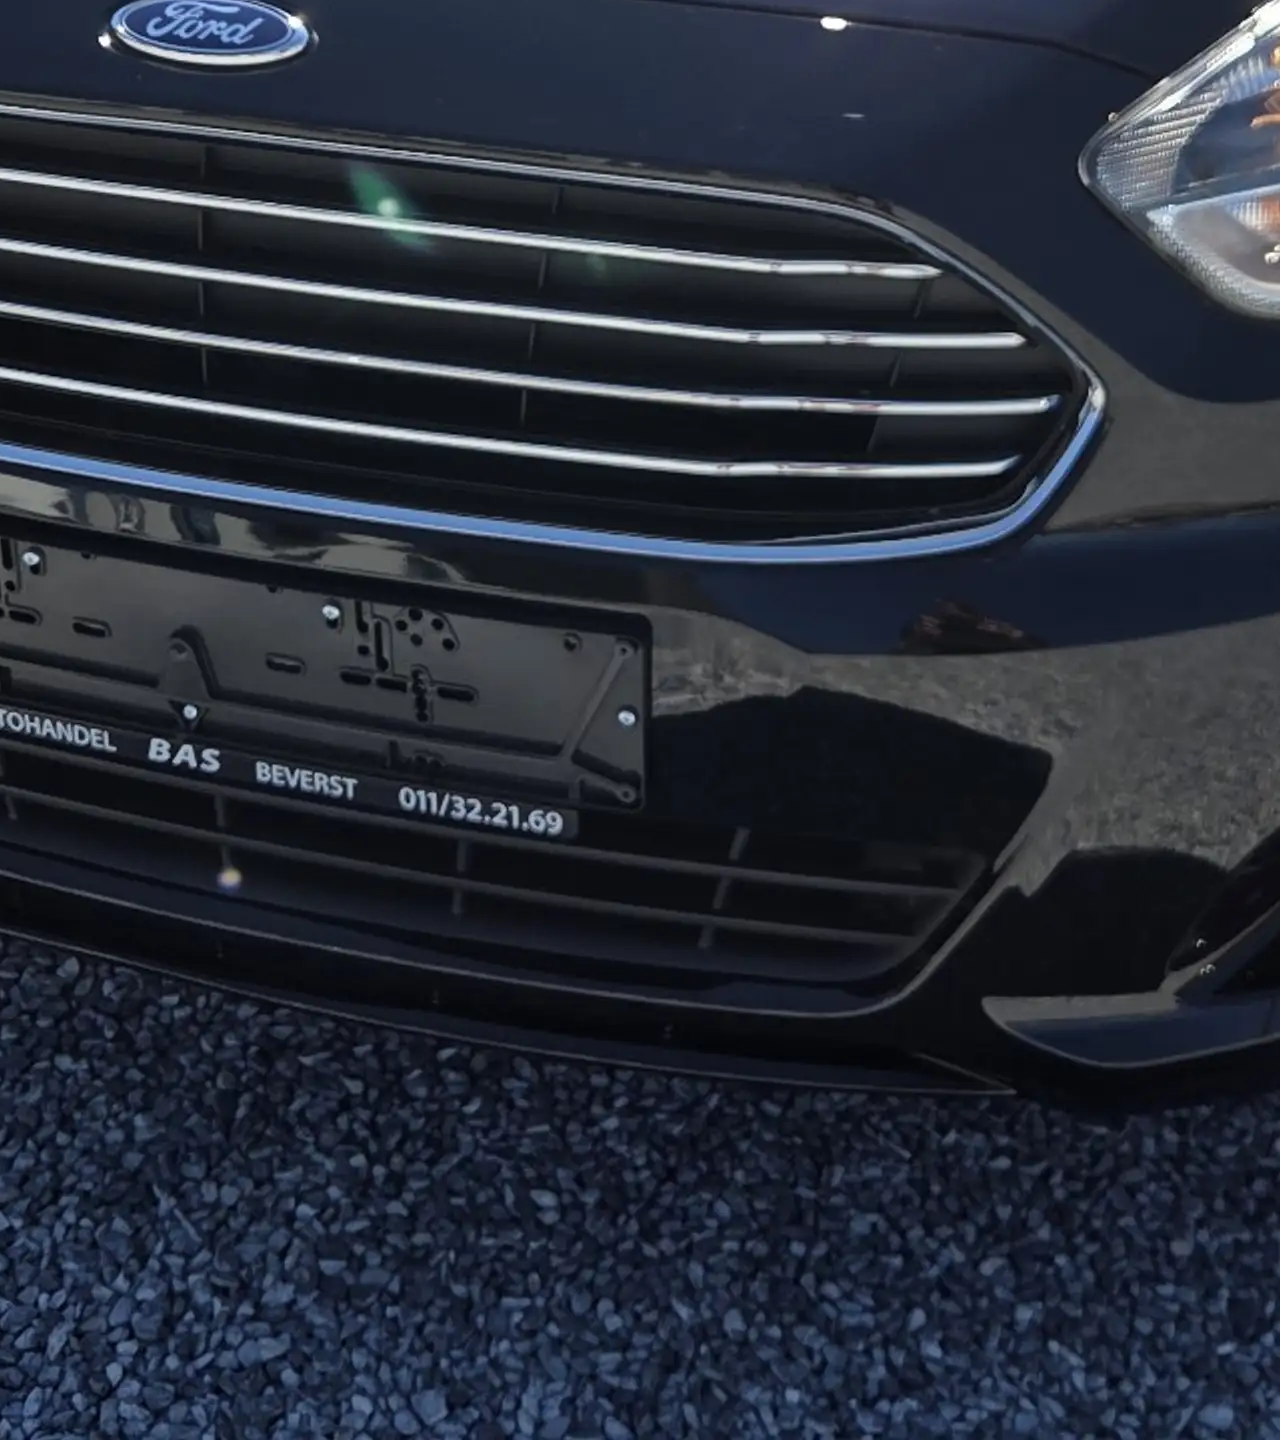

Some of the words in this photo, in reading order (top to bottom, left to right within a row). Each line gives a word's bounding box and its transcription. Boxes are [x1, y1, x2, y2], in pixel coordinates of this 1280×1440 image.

[145, 0, 265, 45] Ford
[147, 737, 221, 773] BAS
[255, 761, 358, 800] BEVERST
[398, 786, 564, 836] 011/32.21.69
